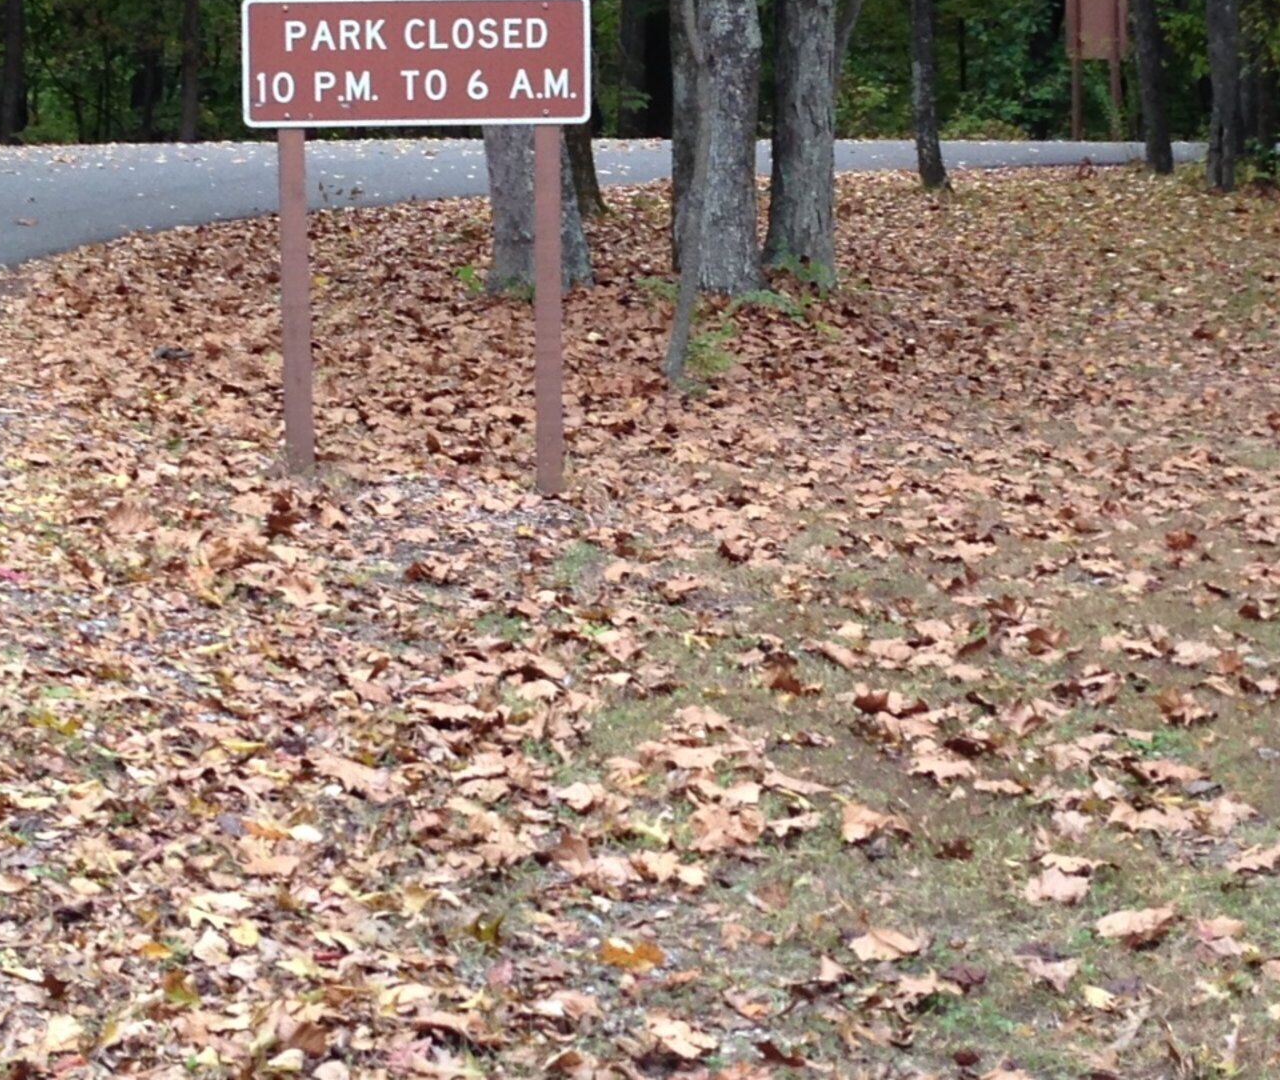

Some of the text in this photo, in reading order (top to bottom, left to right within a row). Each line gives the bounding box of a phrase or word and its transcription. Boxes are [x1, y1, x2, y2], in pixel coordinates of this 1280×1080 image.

[284, 17, 548, 52] PARK CLOSED
[256, 68, 577, 104] 10 P.M. TO 6 A.M.
